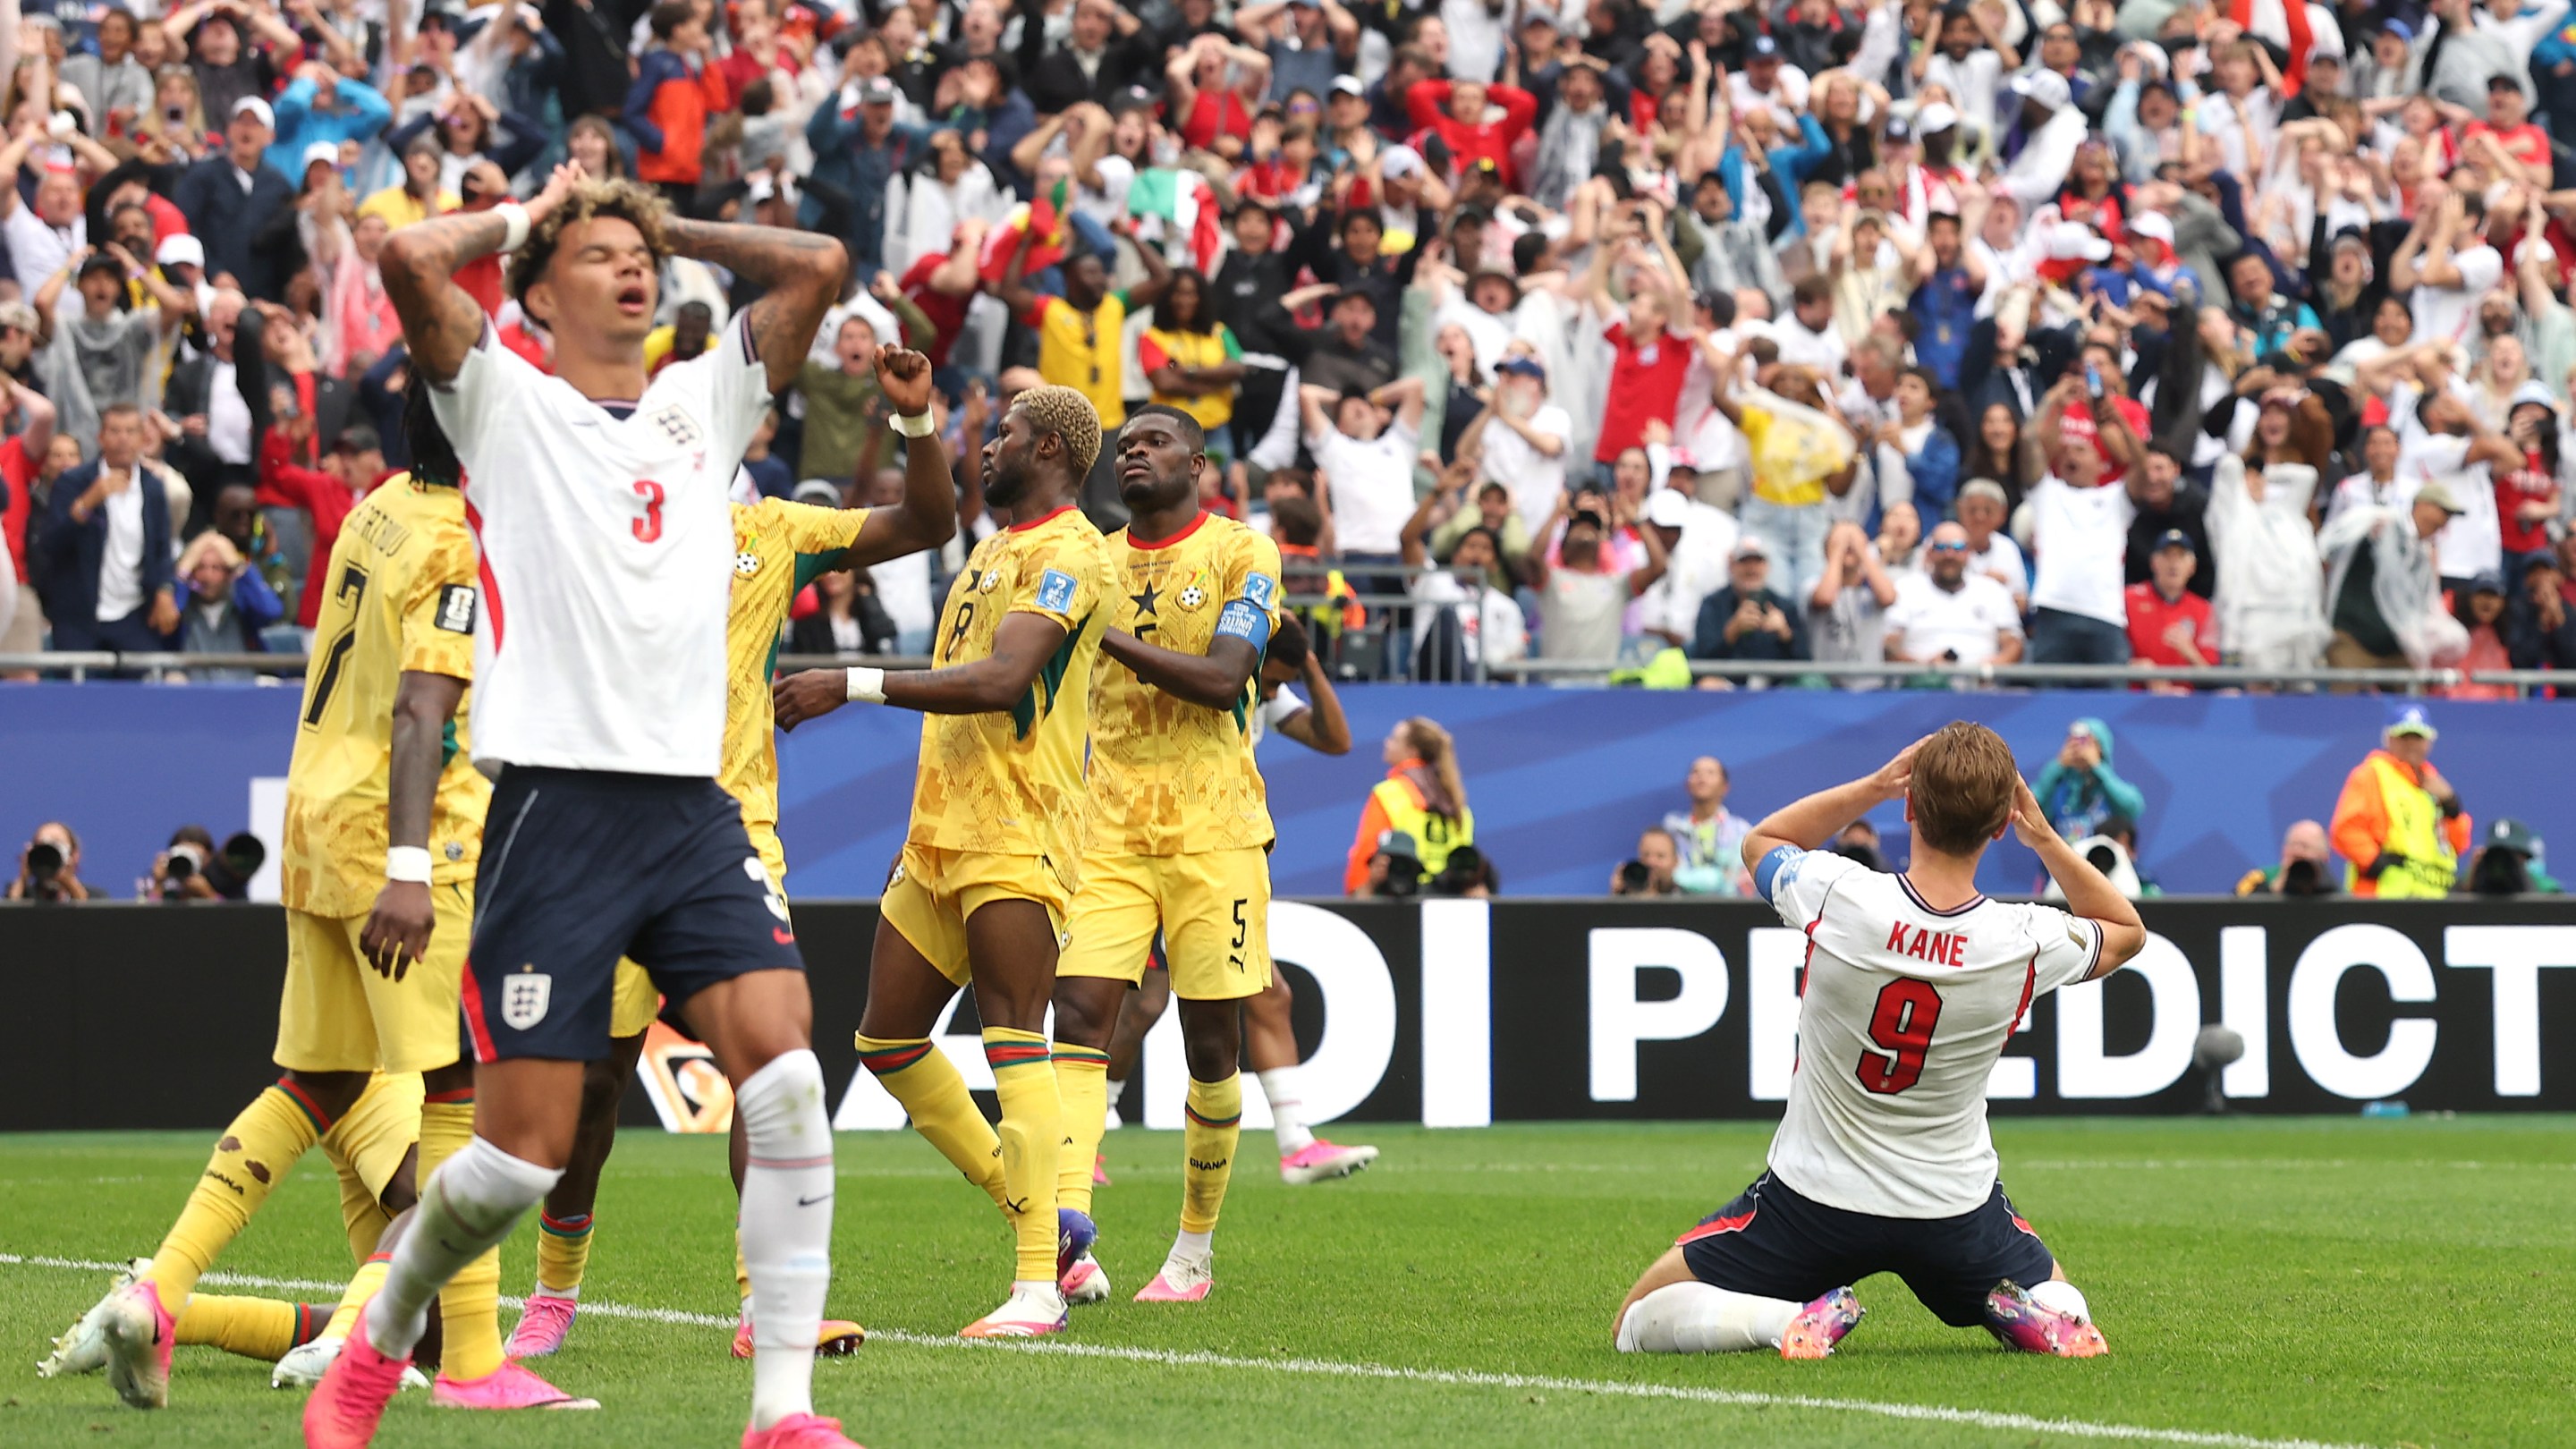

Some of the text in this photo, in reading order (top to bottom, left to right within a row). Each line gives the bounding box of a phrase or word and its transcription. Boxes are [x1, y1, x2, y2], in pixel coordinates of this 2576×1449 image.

[632, 479, 665, 544] 3
[303, 559, 370, 734] 7
[945, 602, 974, 663] 8
[1232, 898, 1248, 949] 5
[1886, 920, 1968, 968] KANE
[1855, 976, 1944, 1095] 9
[1190, 1157, 1227, 1171] GHANA
